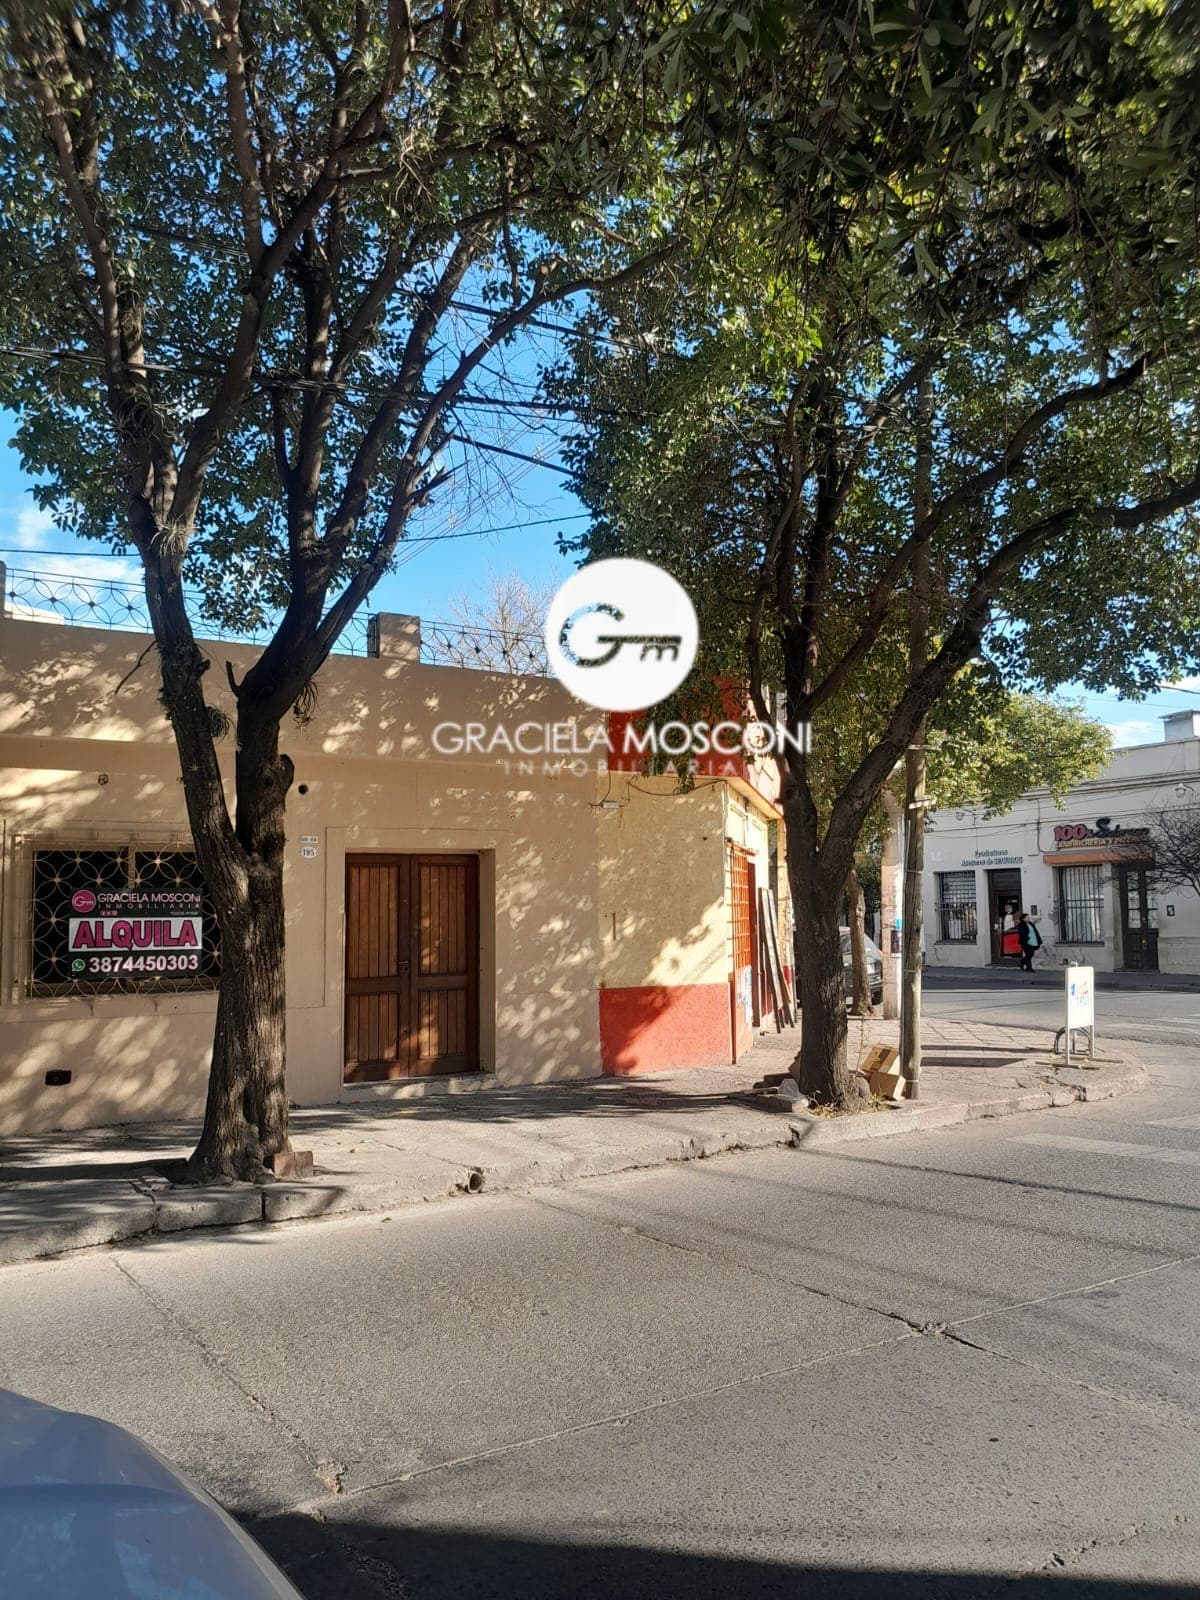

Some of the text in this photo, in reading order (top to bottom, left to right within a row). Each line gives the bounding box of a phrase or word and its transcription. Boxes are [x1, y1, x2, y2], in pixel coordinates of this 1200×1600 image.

[97, 892, 201, 903] GRACIELA MOSCONI
[73, 920, 198, 951] ALQUILA
[90, 955, 198, 973] 3874450303
